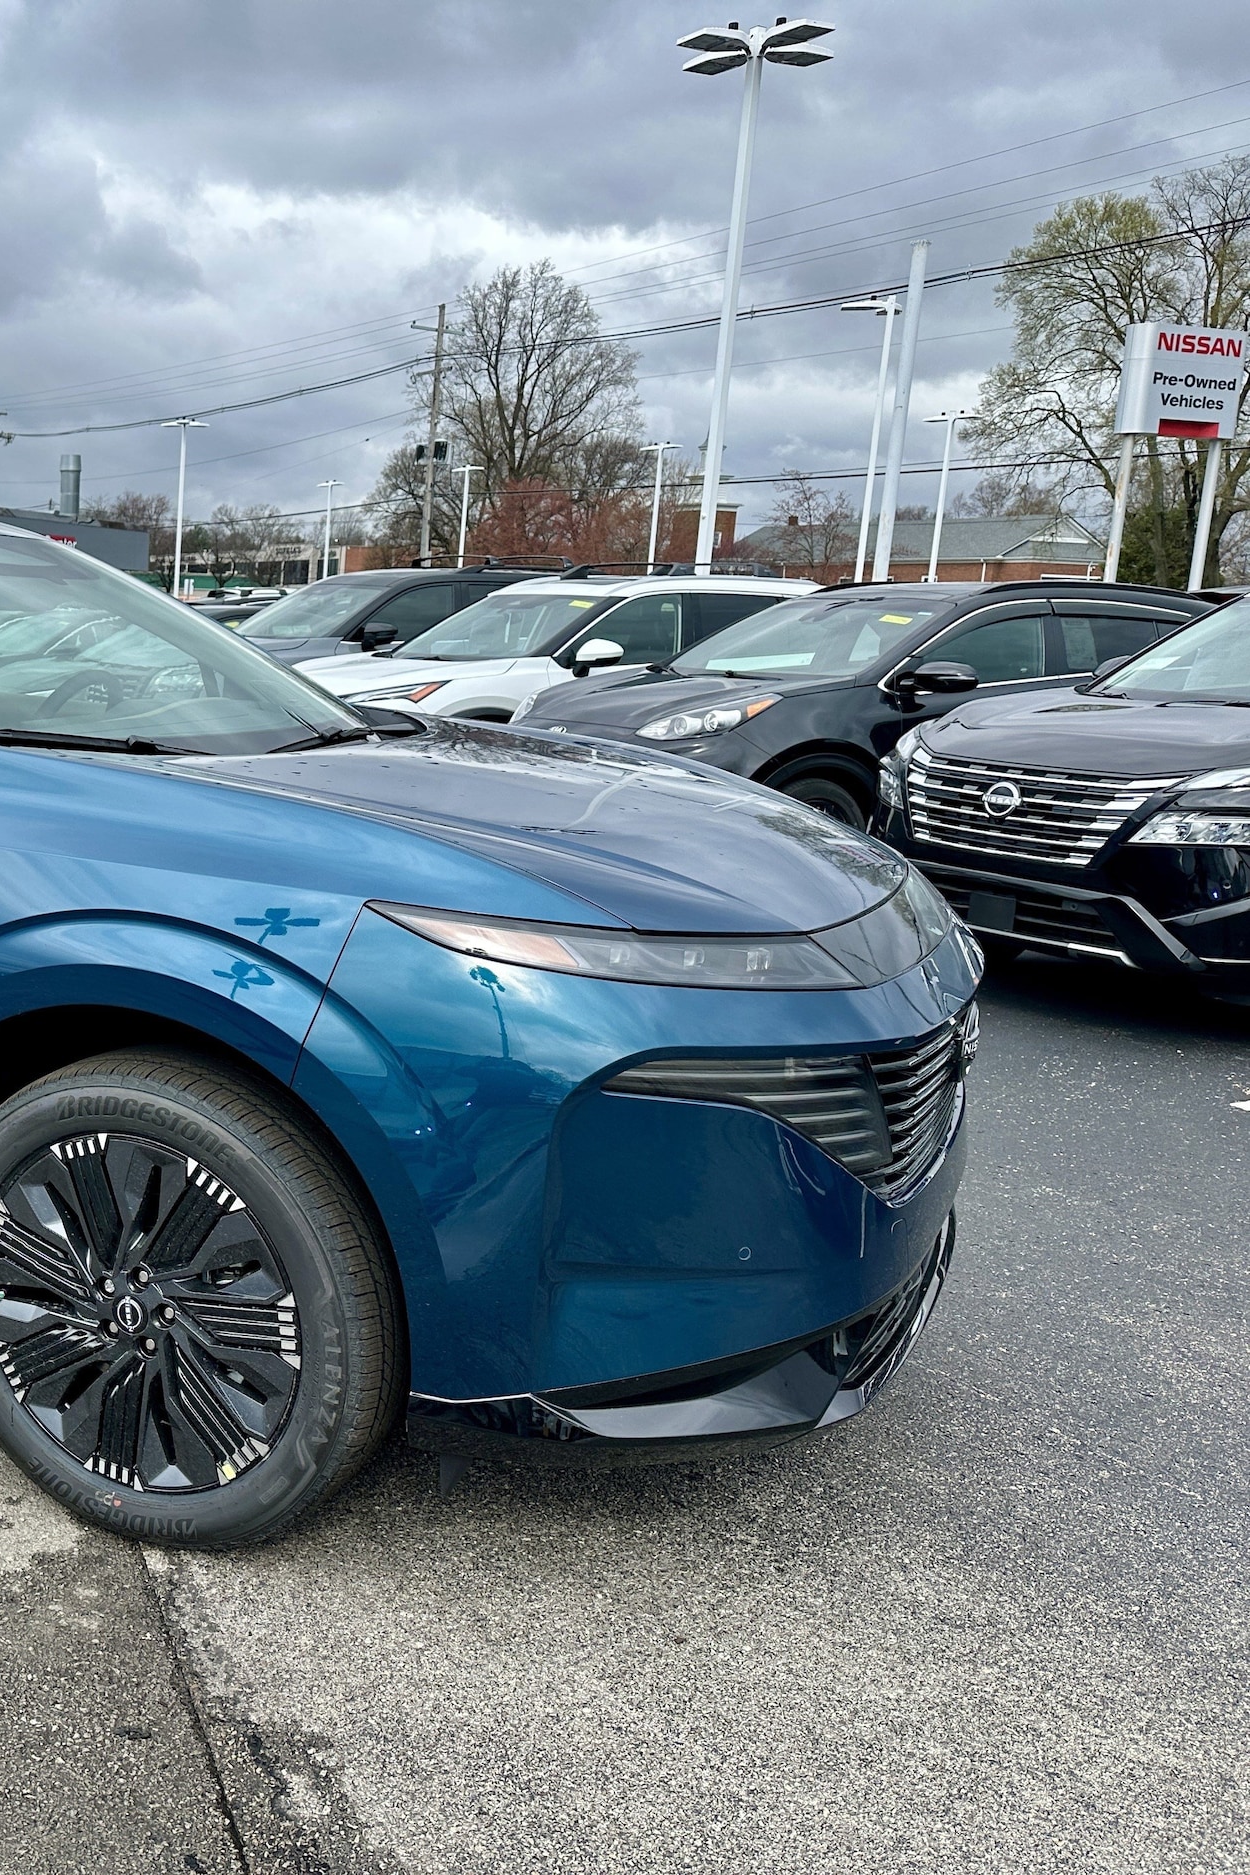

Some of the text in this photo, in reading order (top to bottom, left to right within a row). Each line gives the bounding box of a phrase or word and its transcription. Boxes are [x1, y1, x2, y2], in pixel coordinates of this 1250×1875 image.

[1157, 332, 1242, 358] NISSAN
[1152, 371, 1237, 391] Pre-Owned
[1160, 393, 1224, 410] Vehicles
[981, 793, 1022, 806] NISSAN
[54, 1094, 237, 1164] BRIDGESTONE
[311, 1320, 343, 1446] ALENZA
[28, 1455, 199, 1541] BRIDGESTONE
